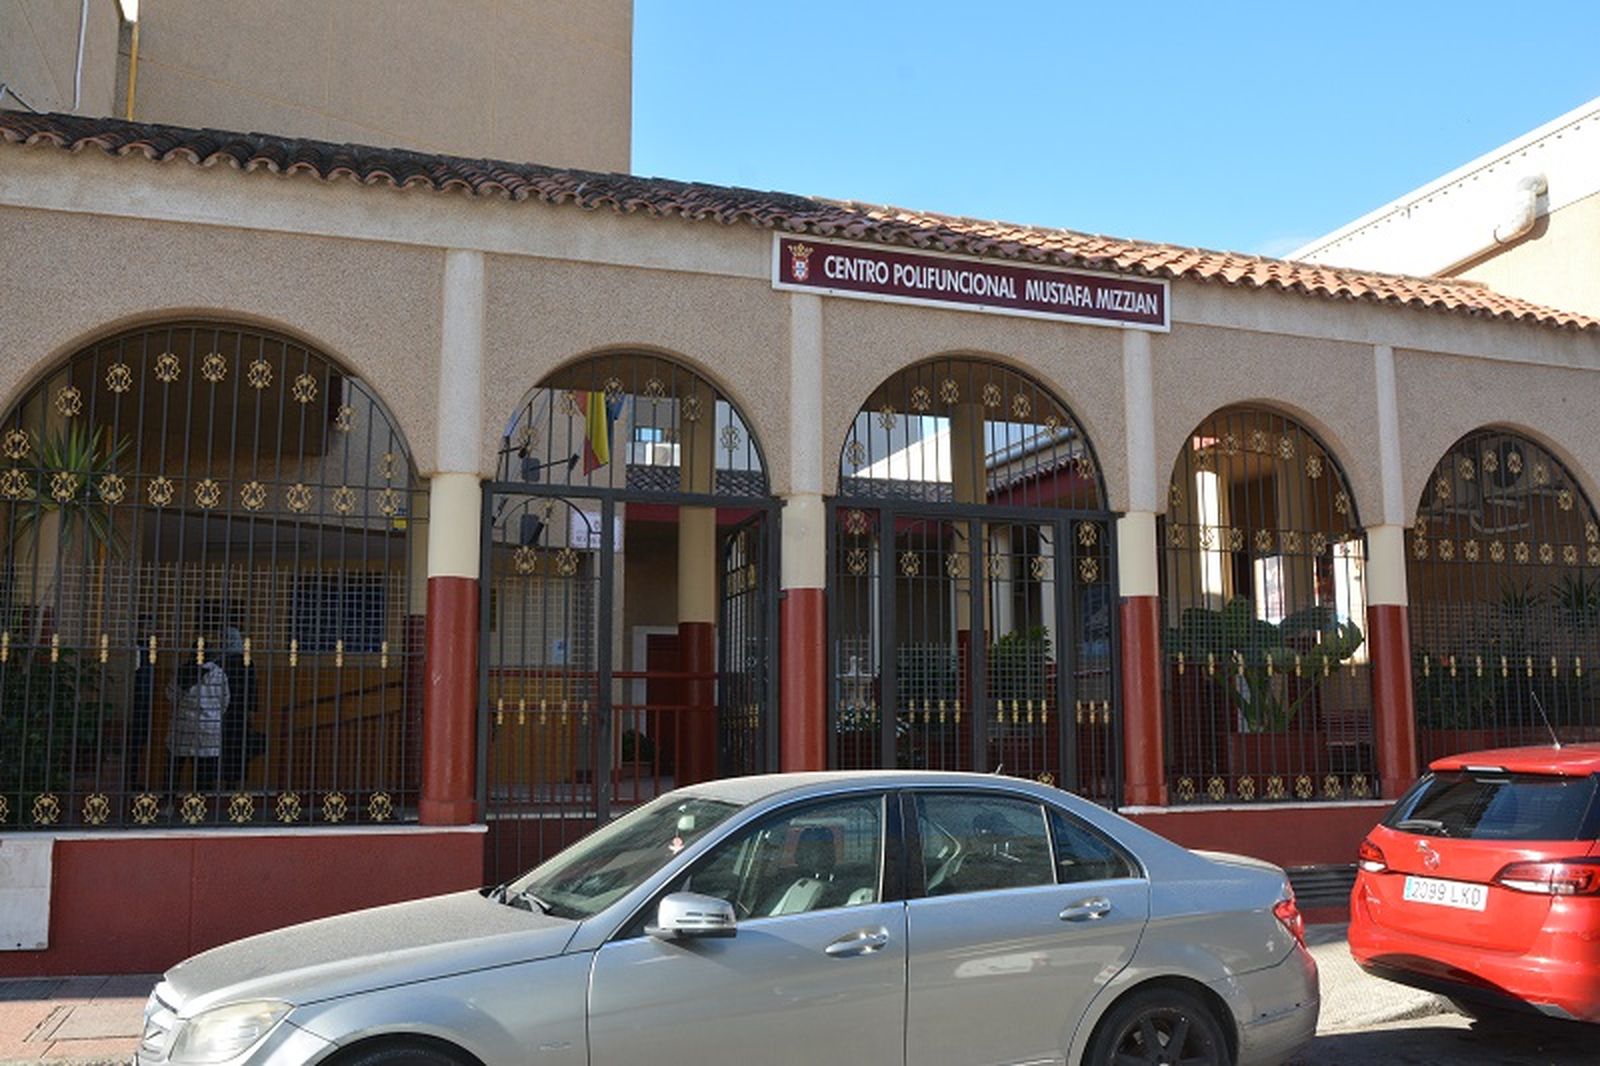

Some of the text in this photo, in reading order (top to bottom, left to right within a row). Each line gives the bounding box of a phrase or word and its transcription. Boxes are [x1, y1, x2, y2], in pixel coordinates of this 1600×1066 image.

[824, 255, 1158, 315] CENTRO POLIFUNCIONAL MUSTAFA MIZZIAN
[1411, 881, 1447, 901] 2099
